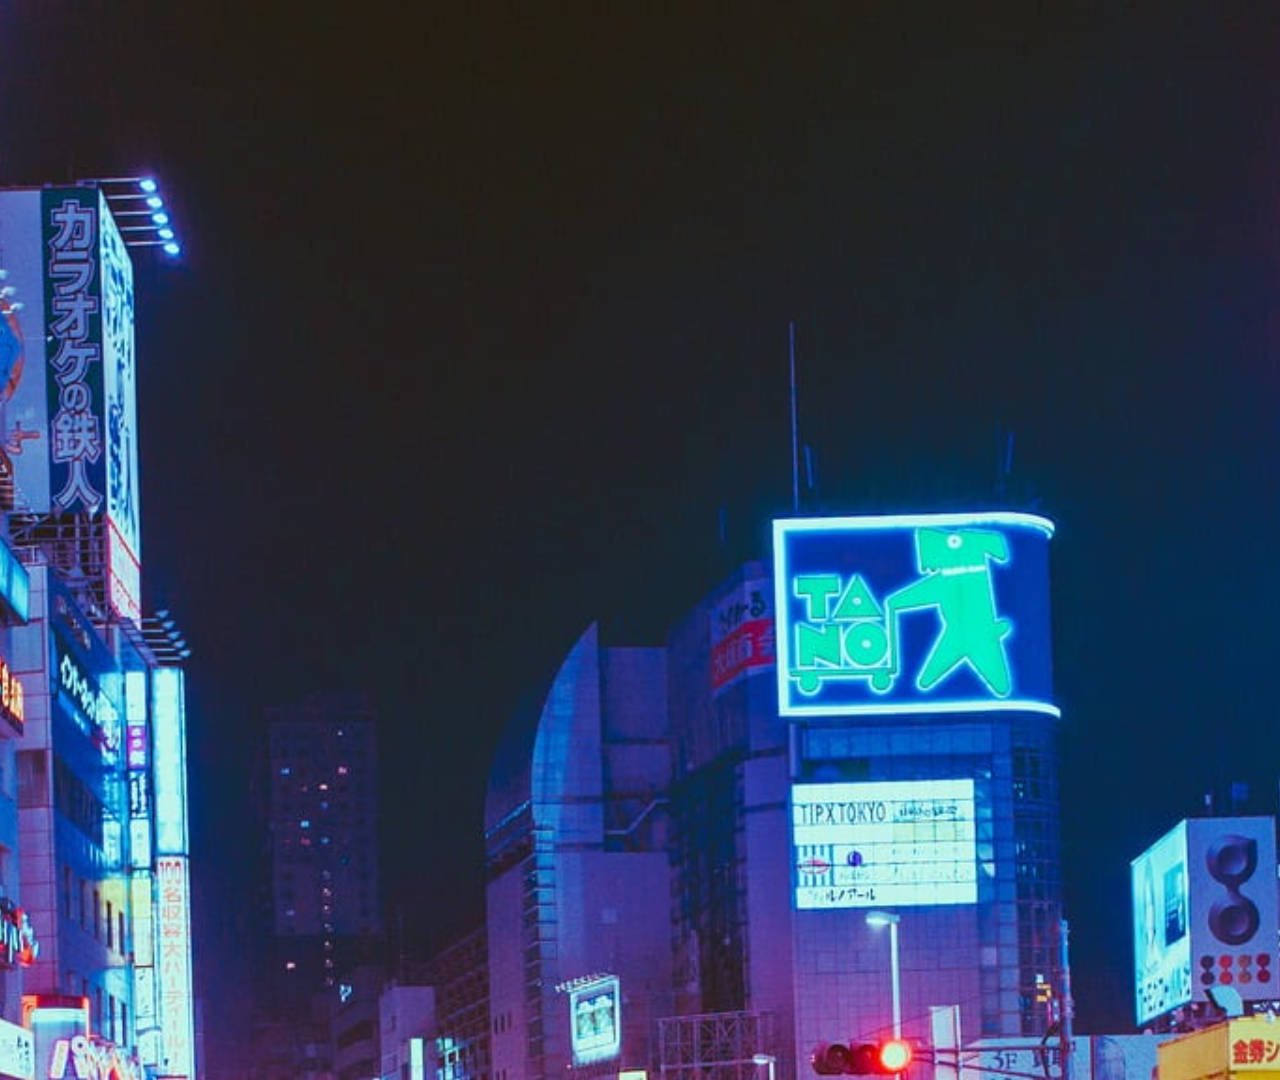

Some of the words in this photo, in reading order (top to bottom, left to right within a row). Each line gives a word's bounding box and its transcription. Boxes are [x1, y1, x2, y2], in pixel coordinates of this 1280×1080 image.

[50, 201, 103, 508] カラオケの鉄人
[795, 574, 885, 620] TA
[796, 621, 889, 667] NO
